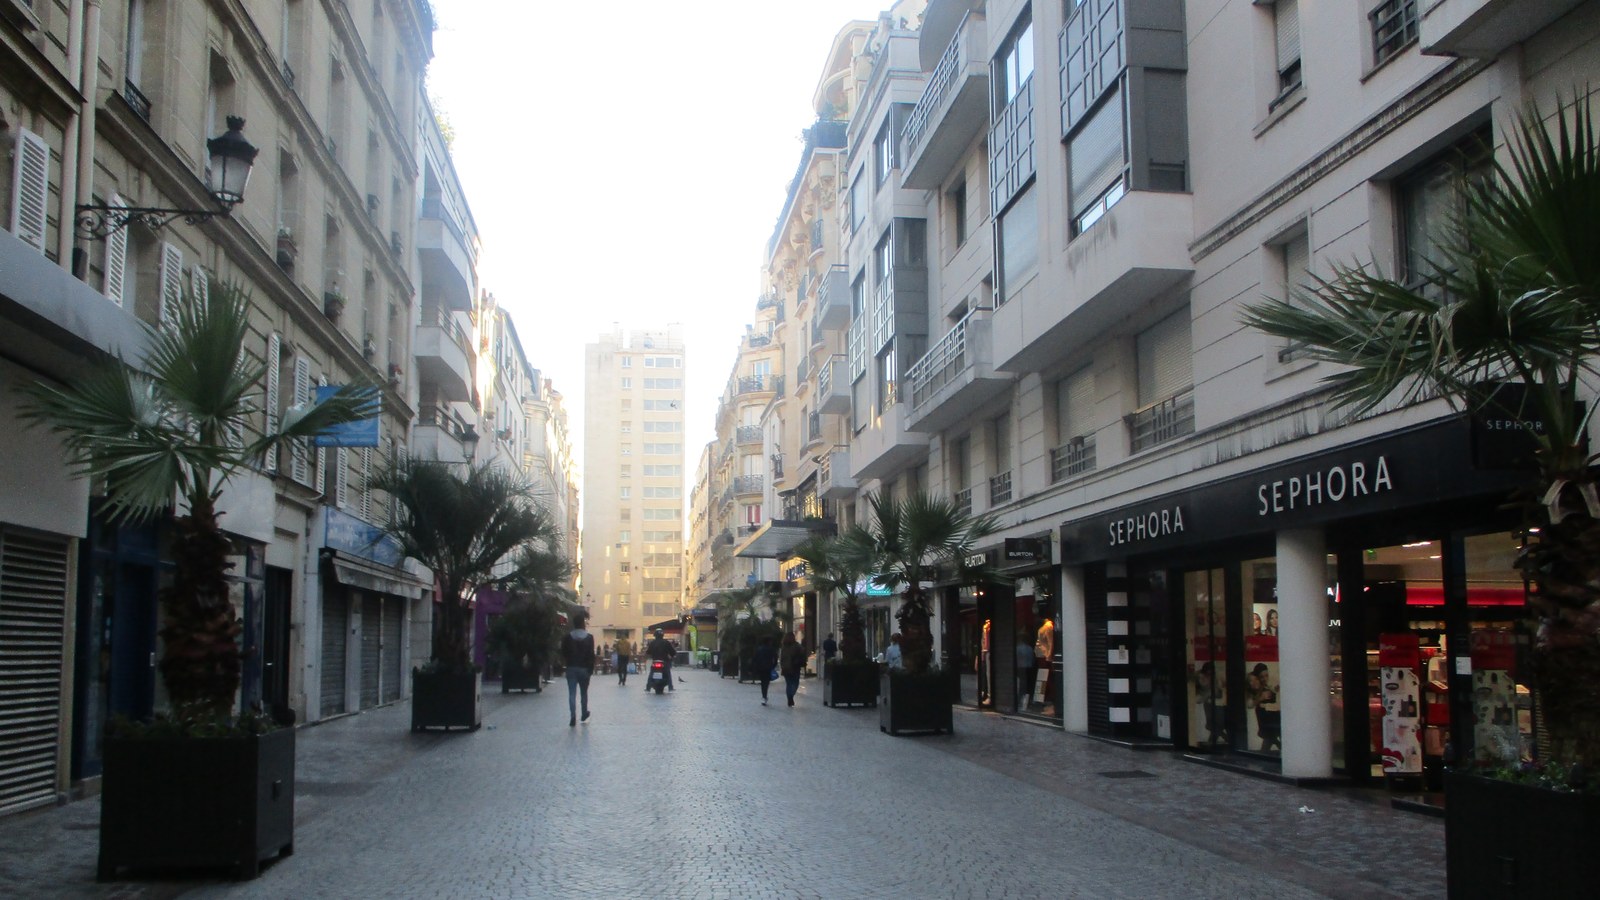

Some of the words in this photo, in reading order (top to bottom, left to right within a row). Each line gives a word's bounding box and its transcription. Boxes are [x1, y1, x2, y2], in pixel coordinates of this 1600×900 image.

[1486, 420, 1542, 431] SEPHOR
[1258, 456, 1392, 516] SEPHORA
[1109, 506, 1184, 546] SEPHORA
